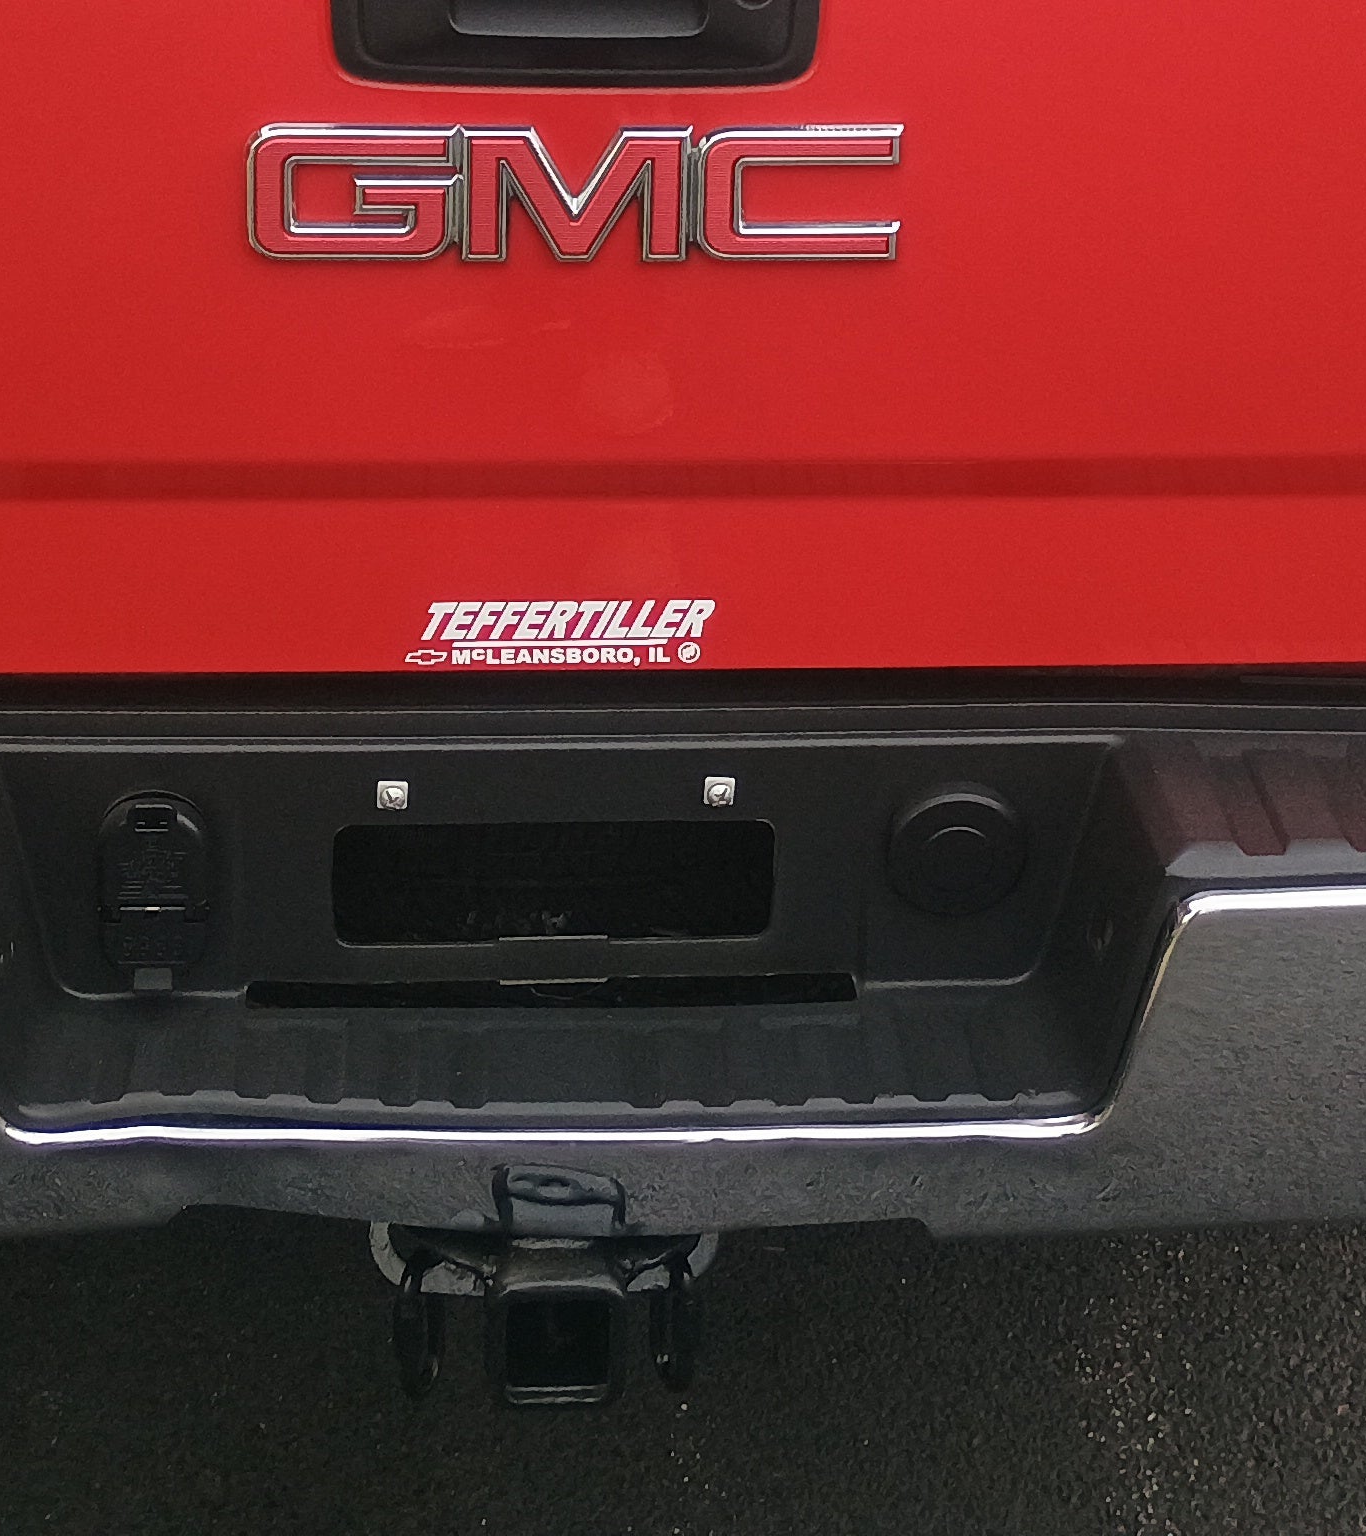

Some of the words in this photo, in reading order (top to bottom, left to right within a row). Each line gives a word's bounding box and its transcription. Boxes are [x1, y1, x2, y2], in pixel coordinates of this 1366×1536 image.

[246, 123, 904, 262] GMC
[420, 599, 716, 641] TEFFERTILLER
[648, 647, 671, 663] IL
